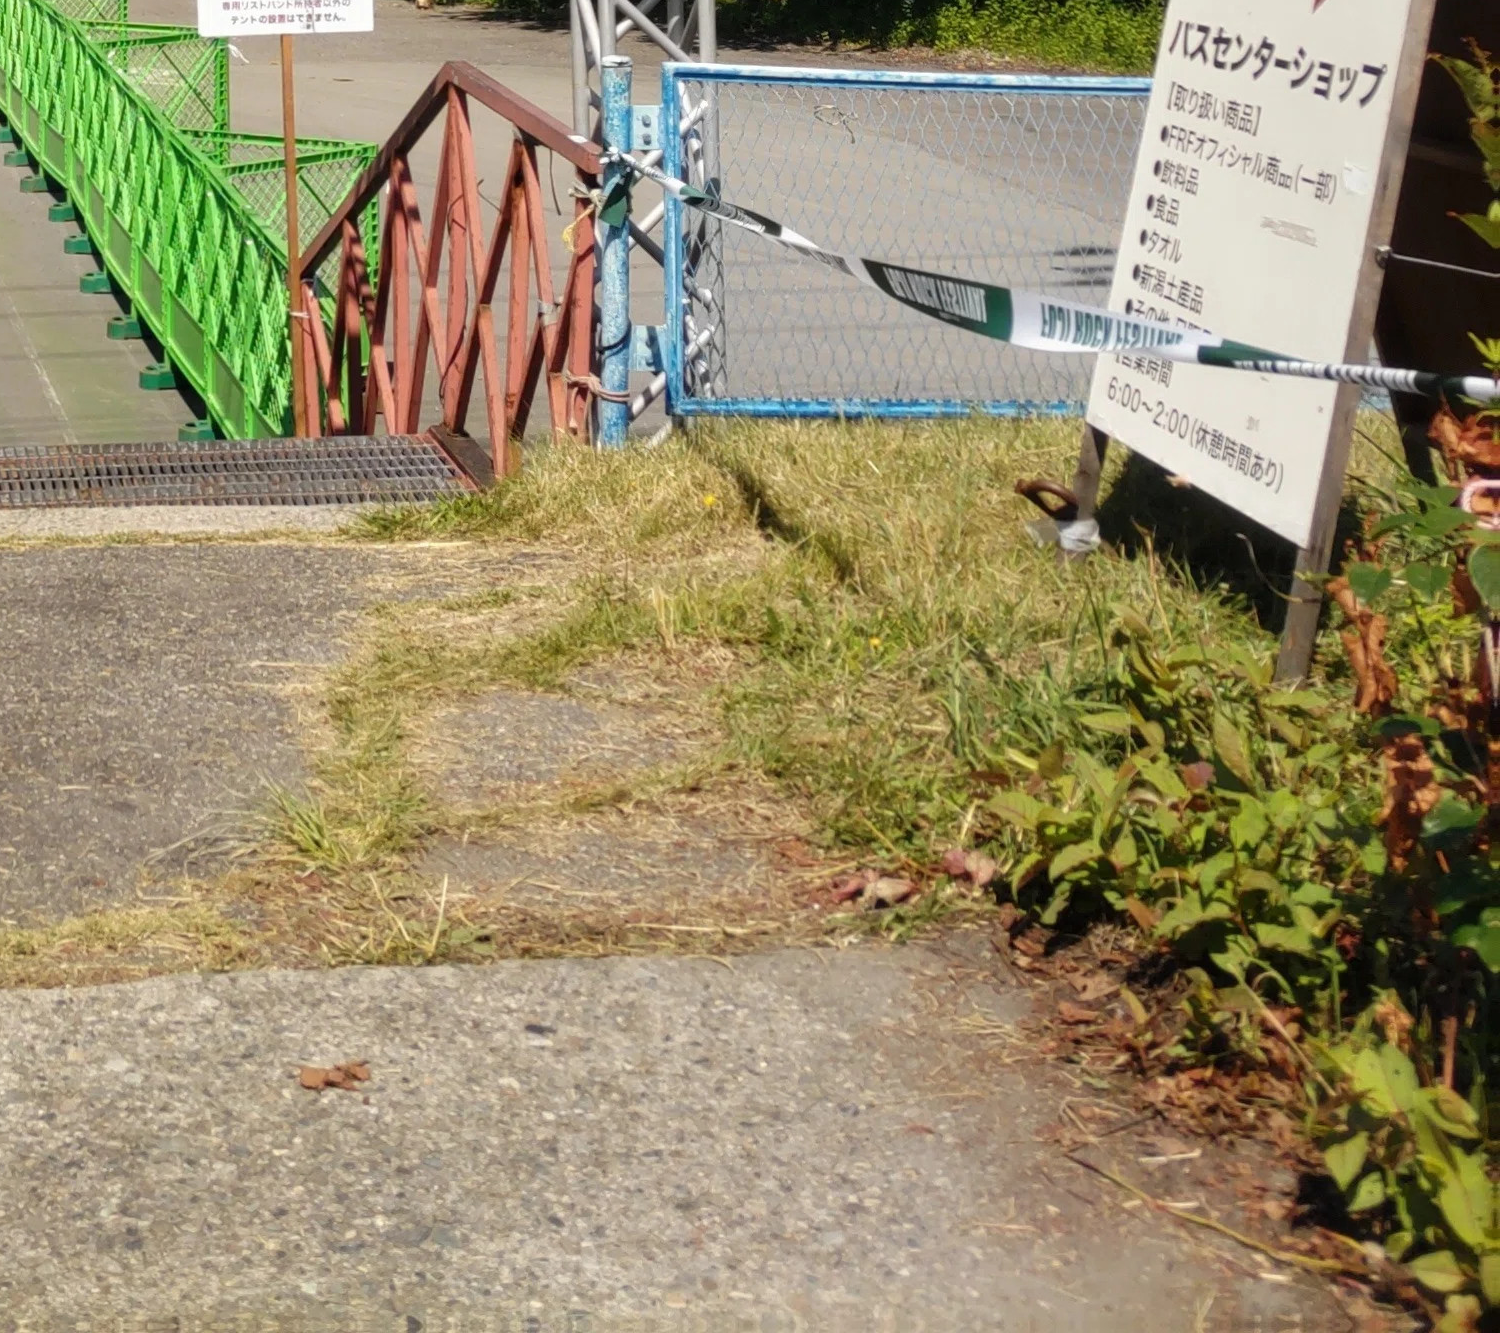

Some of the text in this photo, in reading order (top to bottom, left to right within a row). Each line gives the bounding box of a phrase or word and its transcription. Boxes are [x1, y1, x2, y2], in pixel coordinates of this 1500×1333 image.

[1169, 20, 1388, 109] バスセンターショップ
[1147, 228, 1183, 265] タオル
